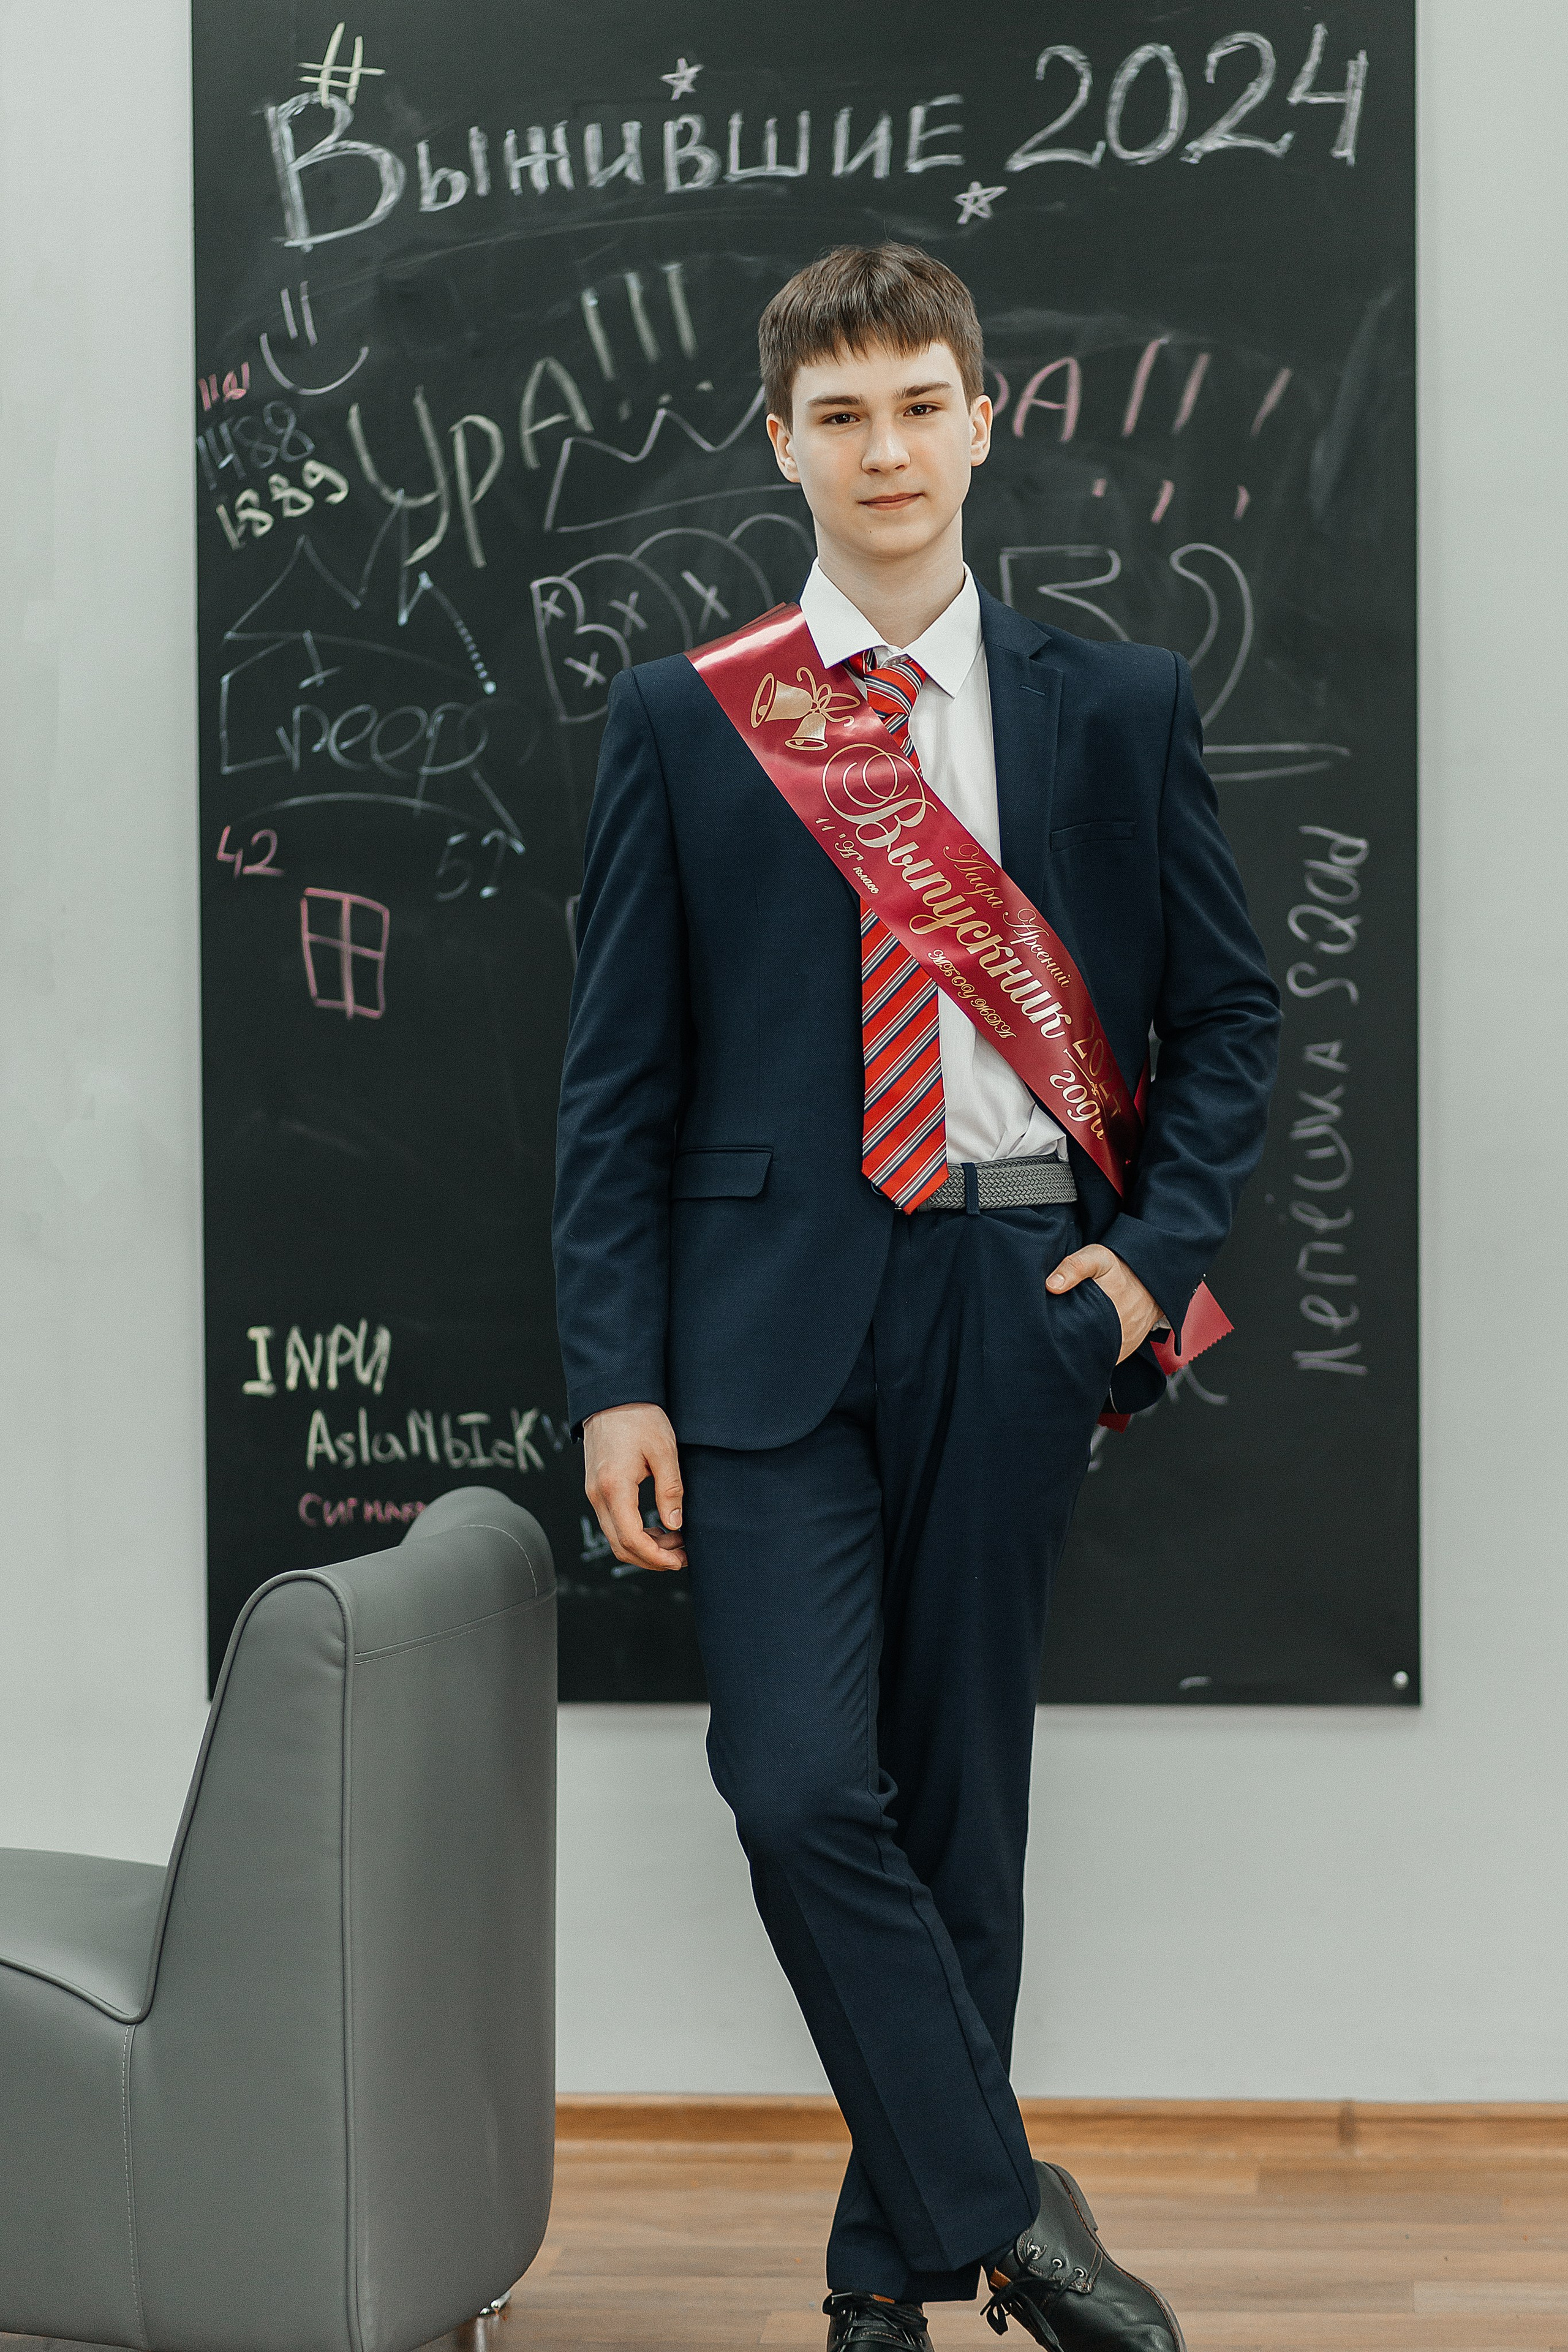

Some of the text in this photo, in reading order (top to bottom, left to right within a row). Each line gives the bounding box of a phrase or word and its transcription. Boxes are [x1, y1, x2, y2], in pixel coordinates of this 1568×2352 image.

[1006, 23, 1368, 169] 2024
[217, 826, 285, 878] 42
[815, 818, 835, 831] 11
[853, 866, 880, 894] класс
[822, 742, 1072, 1039] Выпускник
[943, 843, 1072, 989] Лафа Арсений
[1072, 1017, 1123, 1118] 2024
